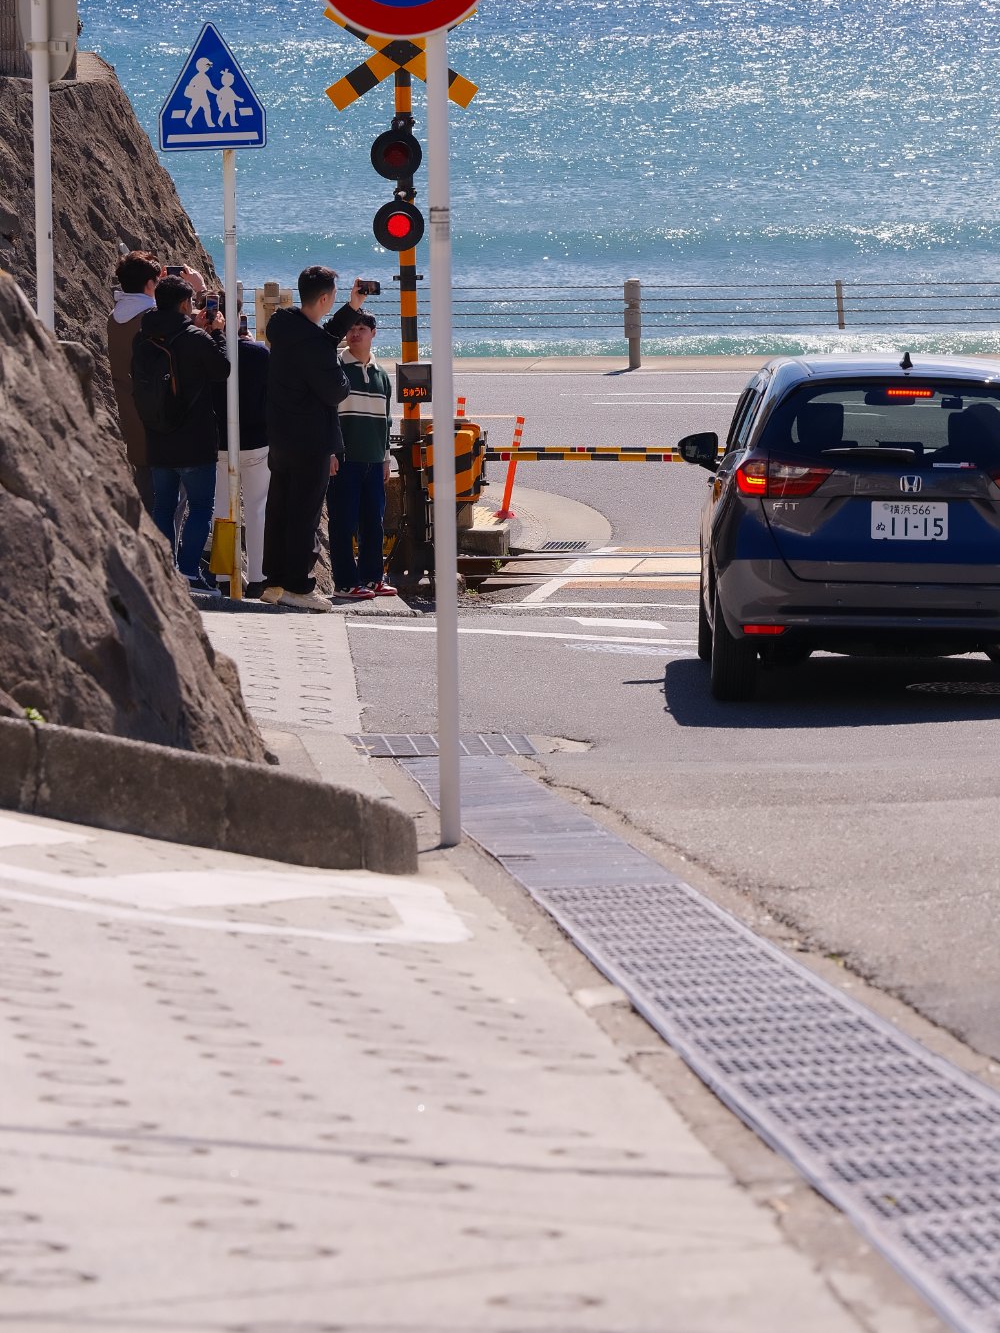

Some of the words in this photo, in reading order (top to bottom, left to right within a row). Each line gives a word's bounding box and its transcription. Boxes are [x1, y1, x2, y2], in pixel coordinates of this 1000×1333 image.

[402, 387, 427, 397] ちゅうい
[772, 502, 800, 511] FIT
[891, 517, 944, 537] 11-15
